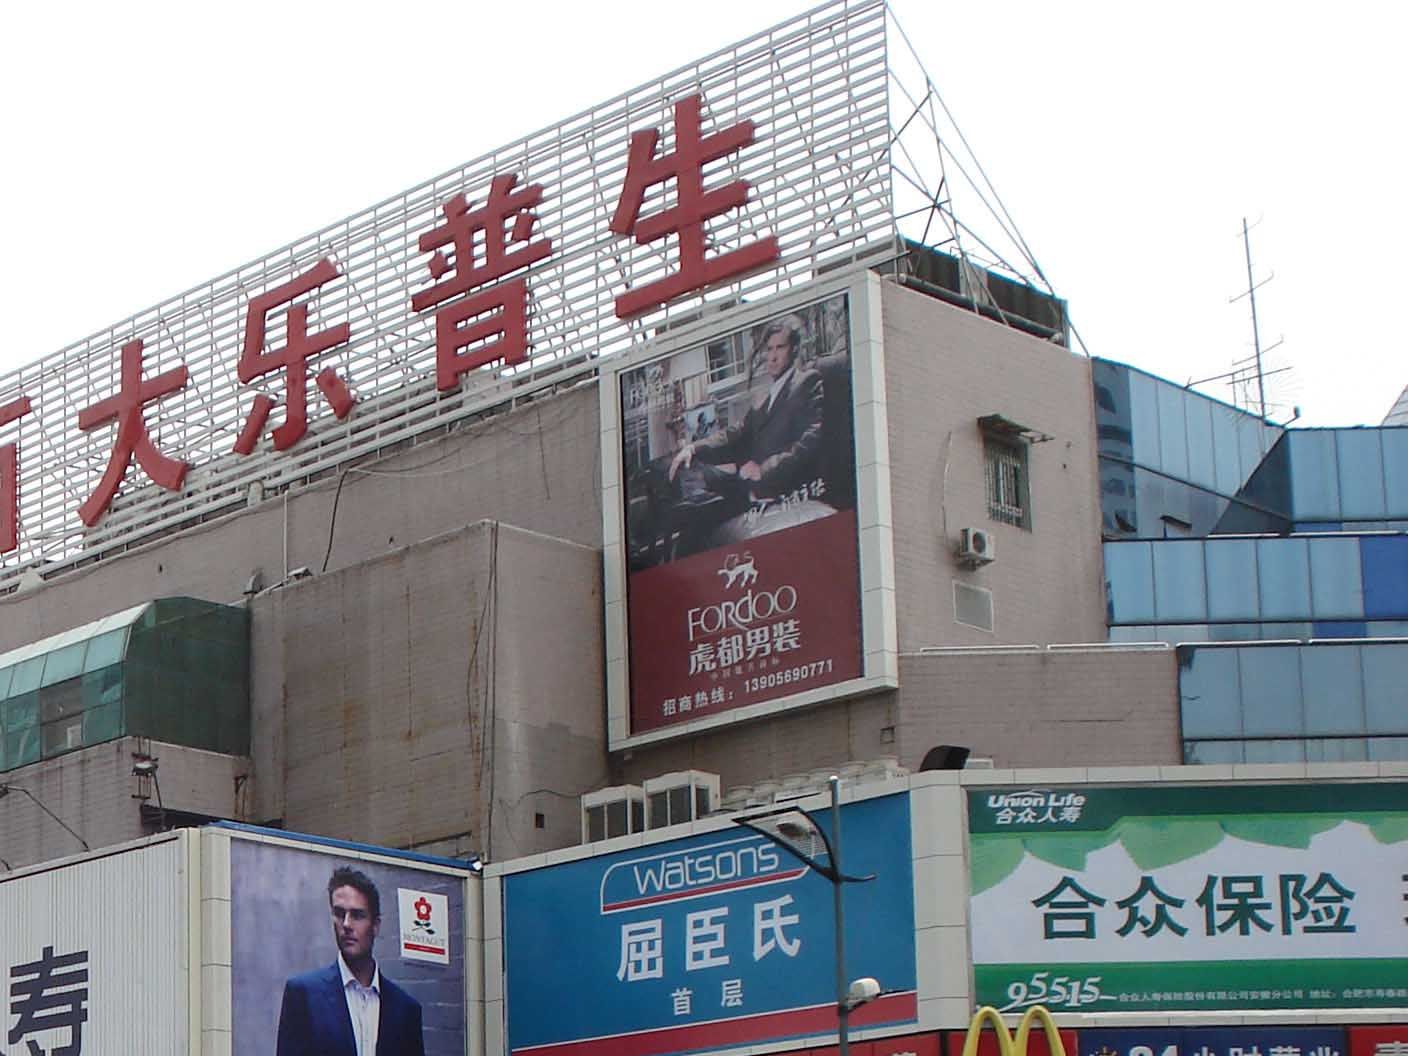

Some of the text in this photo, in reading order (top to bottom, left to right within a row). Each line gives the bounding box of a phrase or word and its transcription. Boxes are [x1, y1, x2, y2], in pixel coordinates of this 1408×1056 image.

[688, 619, 801, 676] 虎都男装
[744, 659, 833, 693] 13905690771
[988, 792, 1086, 808] Union Life
[995, 807, 1082, 825] 合众人寿
[1031, 872, 1357, 940] 合众保险
[616, 894, 801, 982] 屈臣氏
[670, 979, 744, 1017] 首层
[1006, 972, 1103, 1008] 95515
